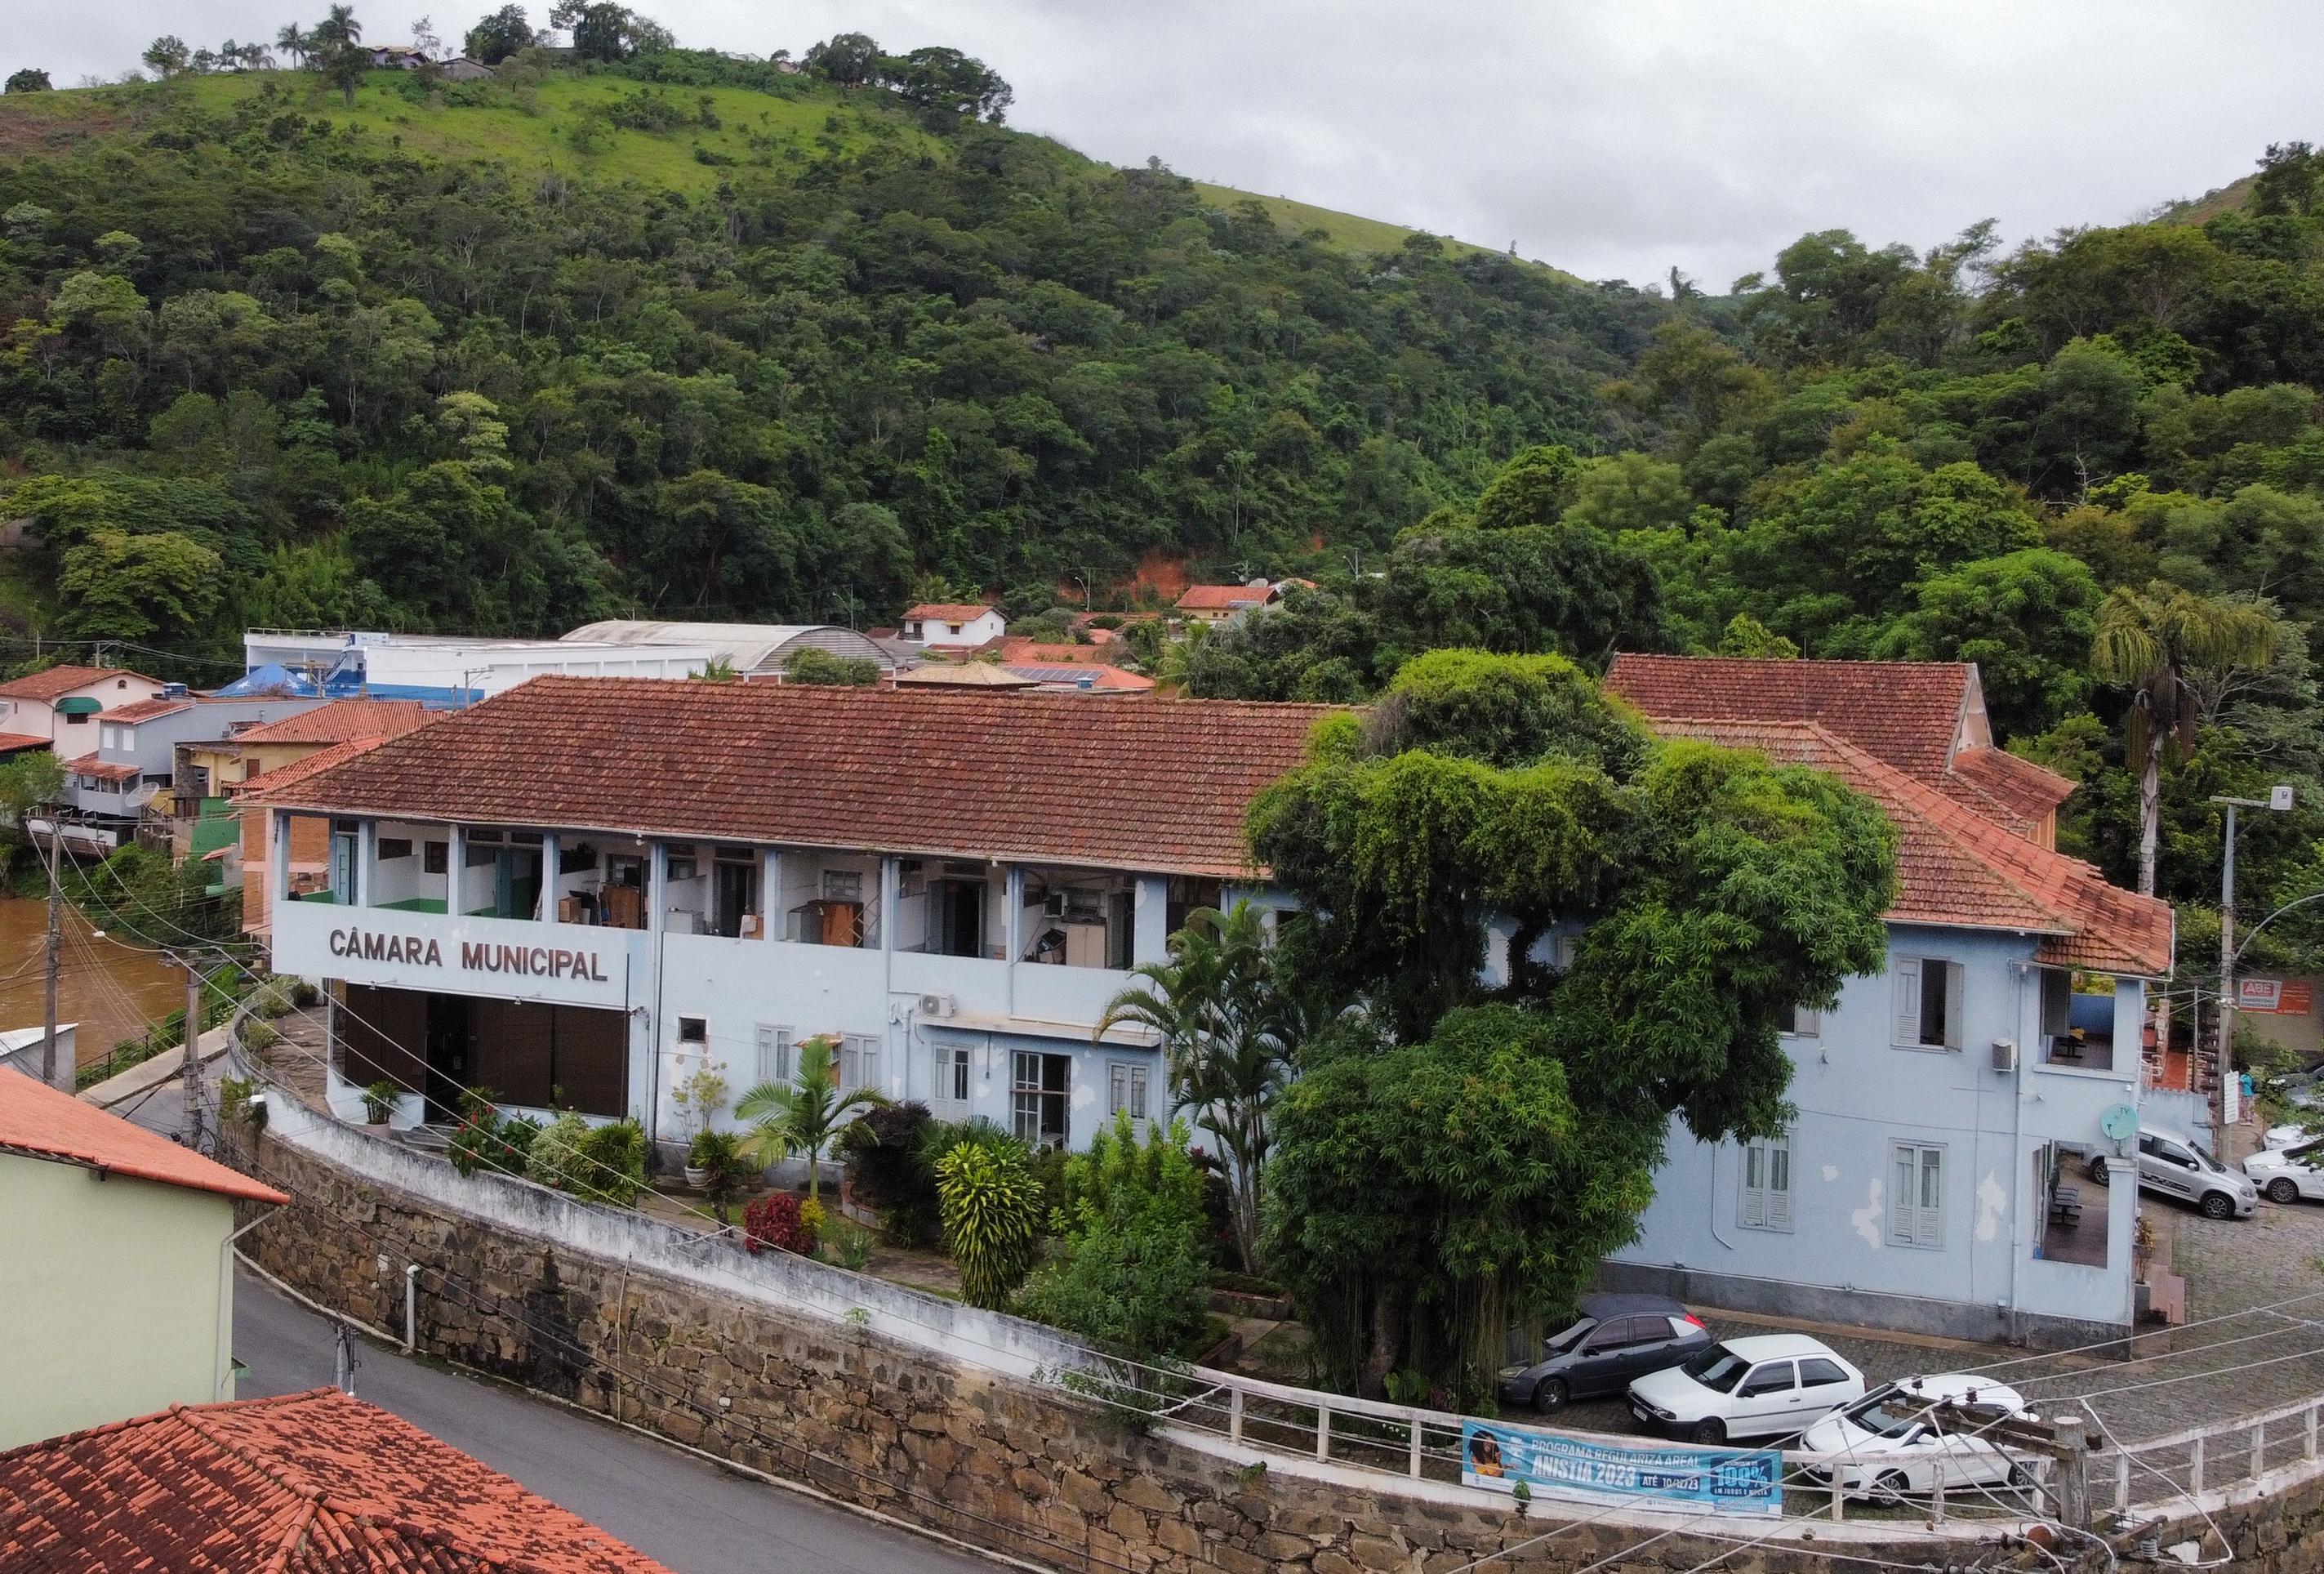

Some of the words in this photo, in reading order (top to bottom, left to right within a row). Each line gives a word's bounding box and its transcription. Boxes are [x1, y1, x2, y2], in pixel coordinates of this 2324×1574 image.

[330, 926, 443, 967] CÂMARA
[462, 942, 608, 981] MUNICIPAL
[1532, 1439, 1592, 1457] PROGRAMA
[1595, 1449, 1663, 1465] REGULARIZA
[1664, 1455, 1699, 1468] AREAL
[1532, 1455, 1592, 1483] ANISTIA
[1595, 1462, 1636, 1487] 2023
[1642, 1474, 1658, 1487] ATÉ
[1716, 1465, 1767, 1487] 100%
